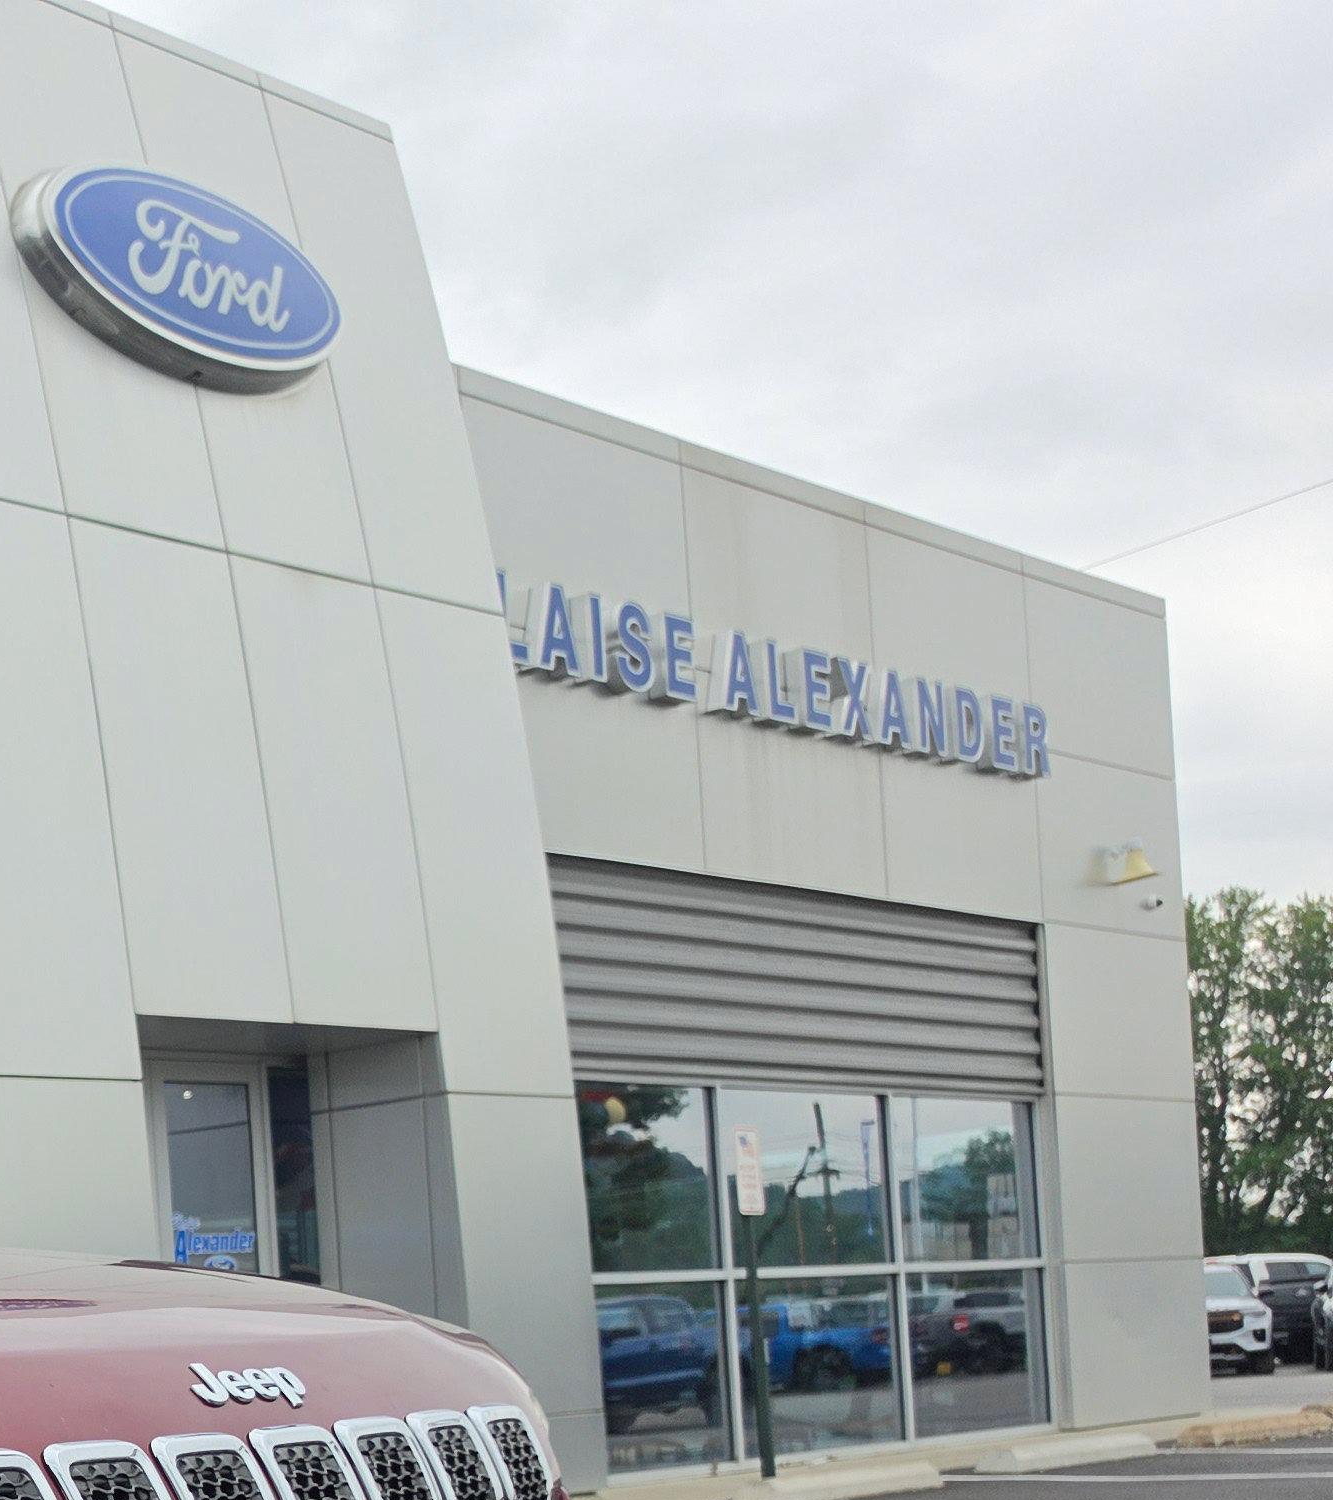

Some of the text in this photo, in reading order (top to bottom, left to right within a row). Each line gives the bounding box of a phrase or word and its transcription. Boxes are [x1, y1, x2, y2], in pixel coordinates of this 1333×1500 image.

[128, 199, 291, 333] Ford
[725, 629, 1051, 778] ALEXANDER
[175, 1227, 255, 1264] Alexander
[188, 1362, 306, 1408] Jeep
